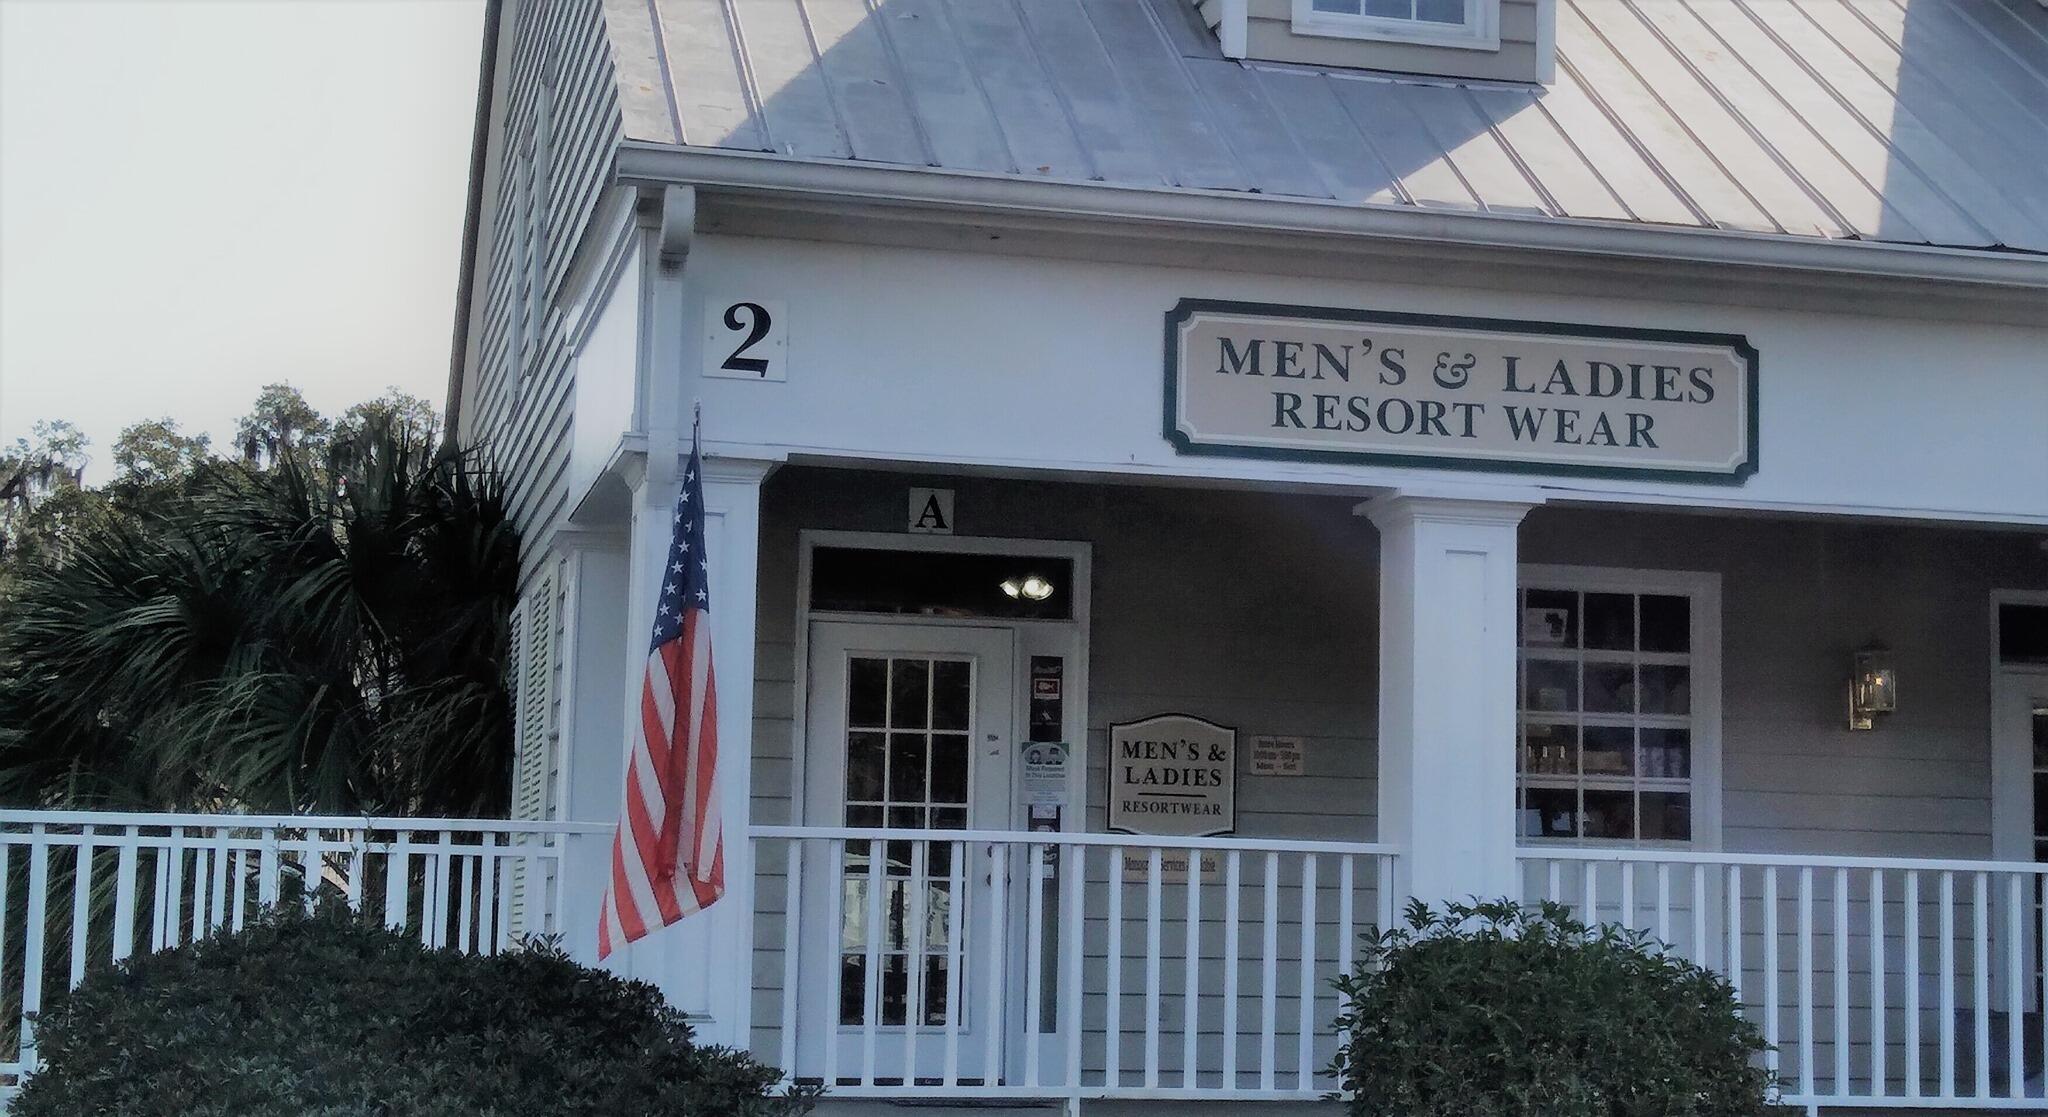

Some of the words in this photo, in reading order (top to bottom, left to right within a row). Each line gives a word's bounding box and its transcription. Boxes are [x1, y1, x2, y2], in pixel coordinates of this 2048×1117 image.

[720, 301, 772, 378] 2
[1215, 335, 1407, 386] MEN'S
[1432, 350, 1476, 390] &
[1501, 355, 1715, 404] LADIES
[1271, 391, 1485, 438] RESORT
[1505, 404, 1660, 449] WEAR
[914, 493, 949, 529] A
[1121, 738, 1200, 762] MEN'S
[1207, 742, 1227, 763] &
[1124, 766, 1223, 788] LADIES
[1122, 799, 1222, 816] RESORTWEAR
